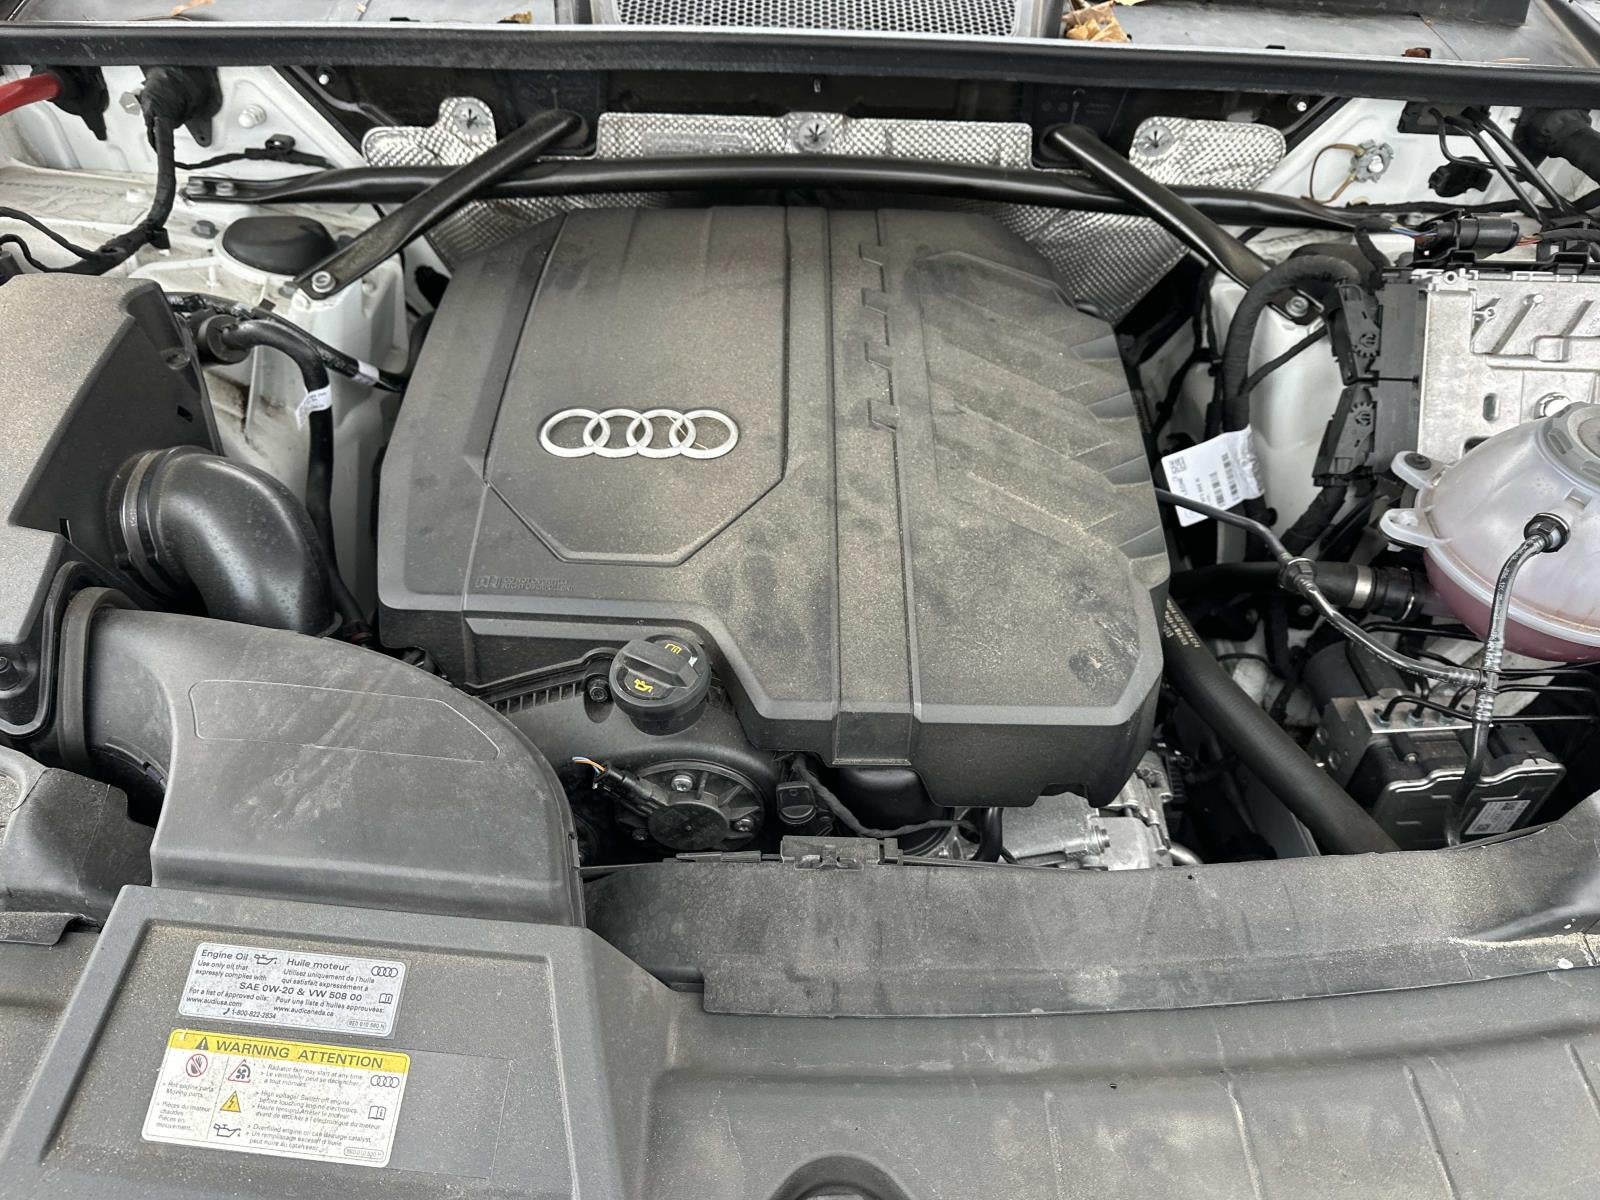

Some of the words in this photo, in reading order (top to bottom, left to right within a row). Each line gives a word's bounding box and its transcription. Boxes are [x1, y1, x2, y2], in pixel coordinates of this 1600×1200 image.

[200, 948, 234, 961] Engine
[234, 951, 249, 960] Oil
[196, 959, 210, 967] Use
[210, 960, 226, 970] only
[234, 963, 249, 971] that
[285, 957, 311, 968] Huile
[312, 960, 350, 972] moteur
[194, 968, 224, 977] expressly
[223, 971, 253, 980] complies
[282, 968, 307, 977] Utilisez
[306, 971, 345, 982] uniquement
[292, 978, 318, 986] satisfait
[188, 986, 200, 994] For
[223, 991, 254, 1001] approved
[238, 981, 260, 991] SAE
[261, 983, 295, 995] 0W-20
[295, 987, 305, 996] &
[307, 988, 327, 998] VW
[328, 990, 348, 1000] 508
[348, 993, 363, 1002] 00
[185, 996, 242, 1007] www.audiusa.com
[304, 998, 319, 1006] liste
[230, 1008, 276, 1020] 1-800-822-2834
[272, 1004, 334, 1017] www.audicanada.ca
[214, 1039, 290, 1058] WARNING
[296, 1048, 383, 1069] ATTENTION
